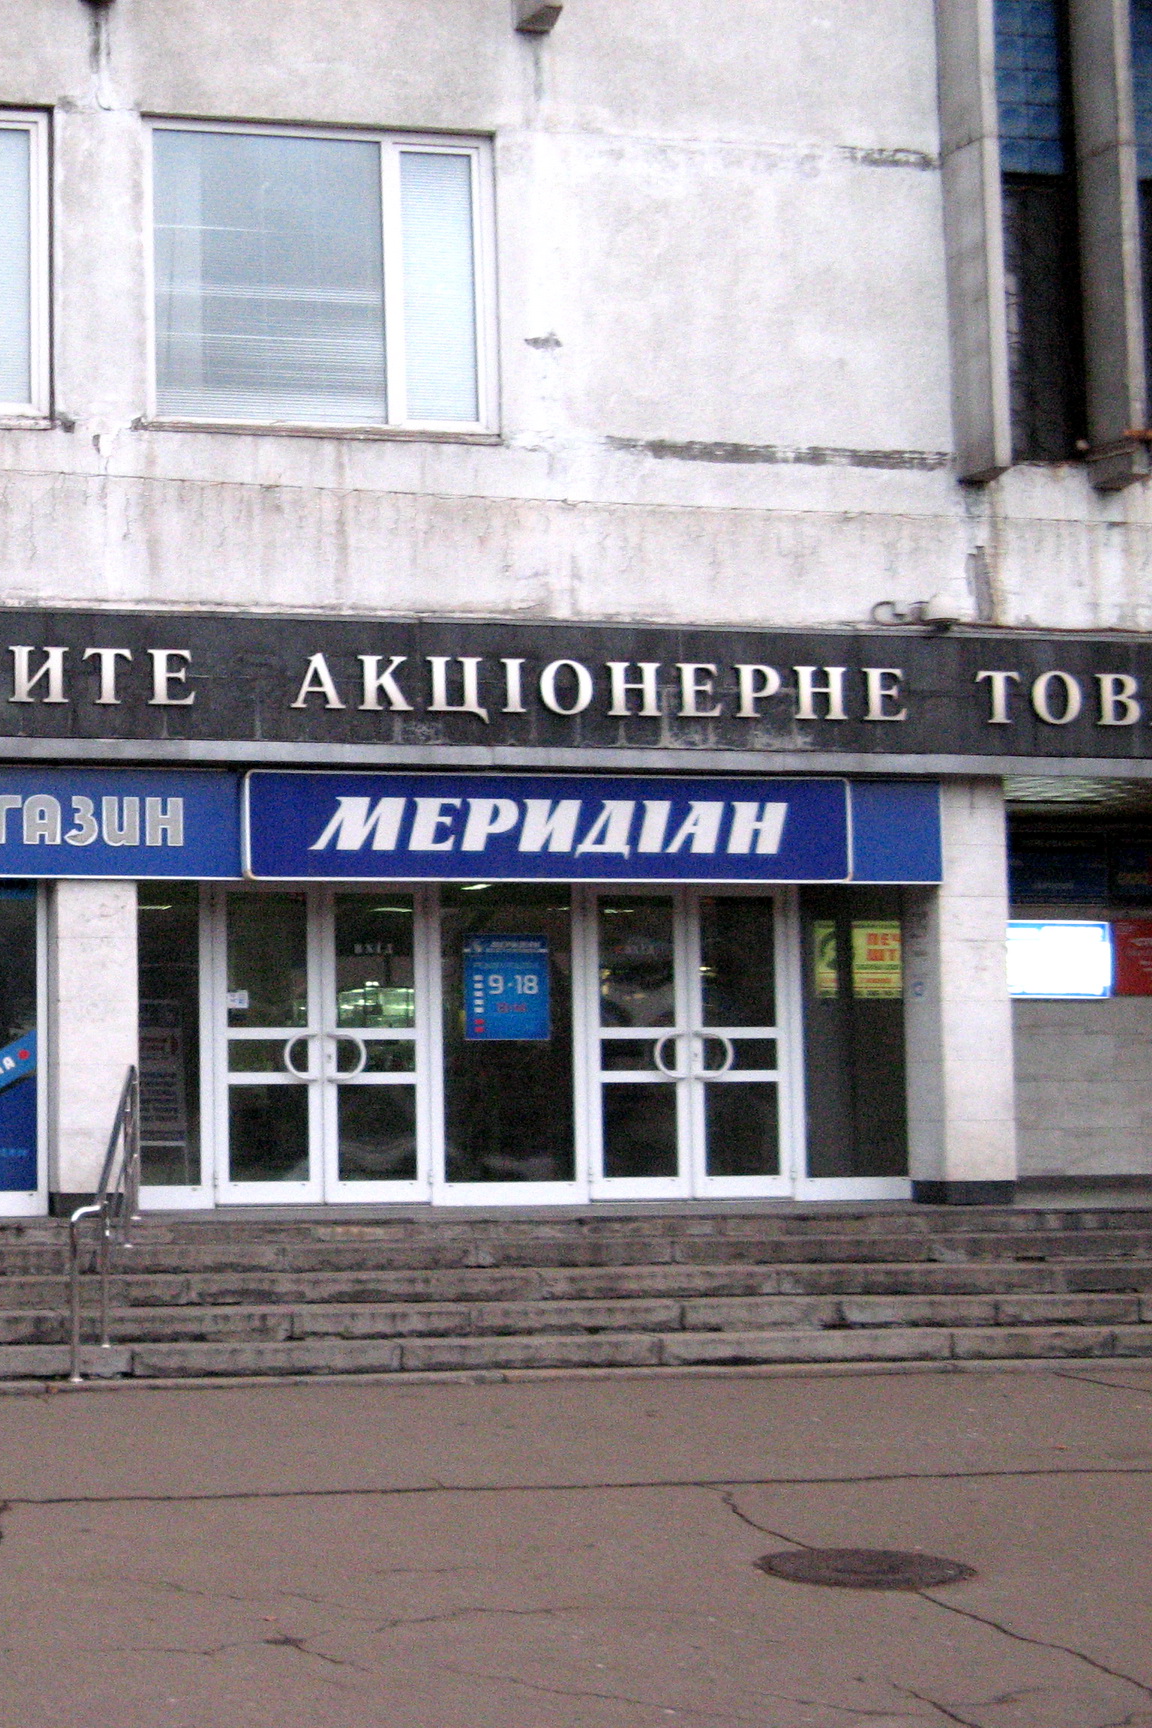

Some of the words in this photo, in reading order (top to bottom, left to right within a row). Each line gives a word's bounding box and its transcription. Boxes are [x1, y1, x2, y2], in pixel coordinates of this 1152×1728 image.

[291, 652, 908, 724] АКЦІОНЕРНЕ
[977, 670, 1152, 726] ТОВ
[309, 796, 789, 858] МЕРИДІАН
